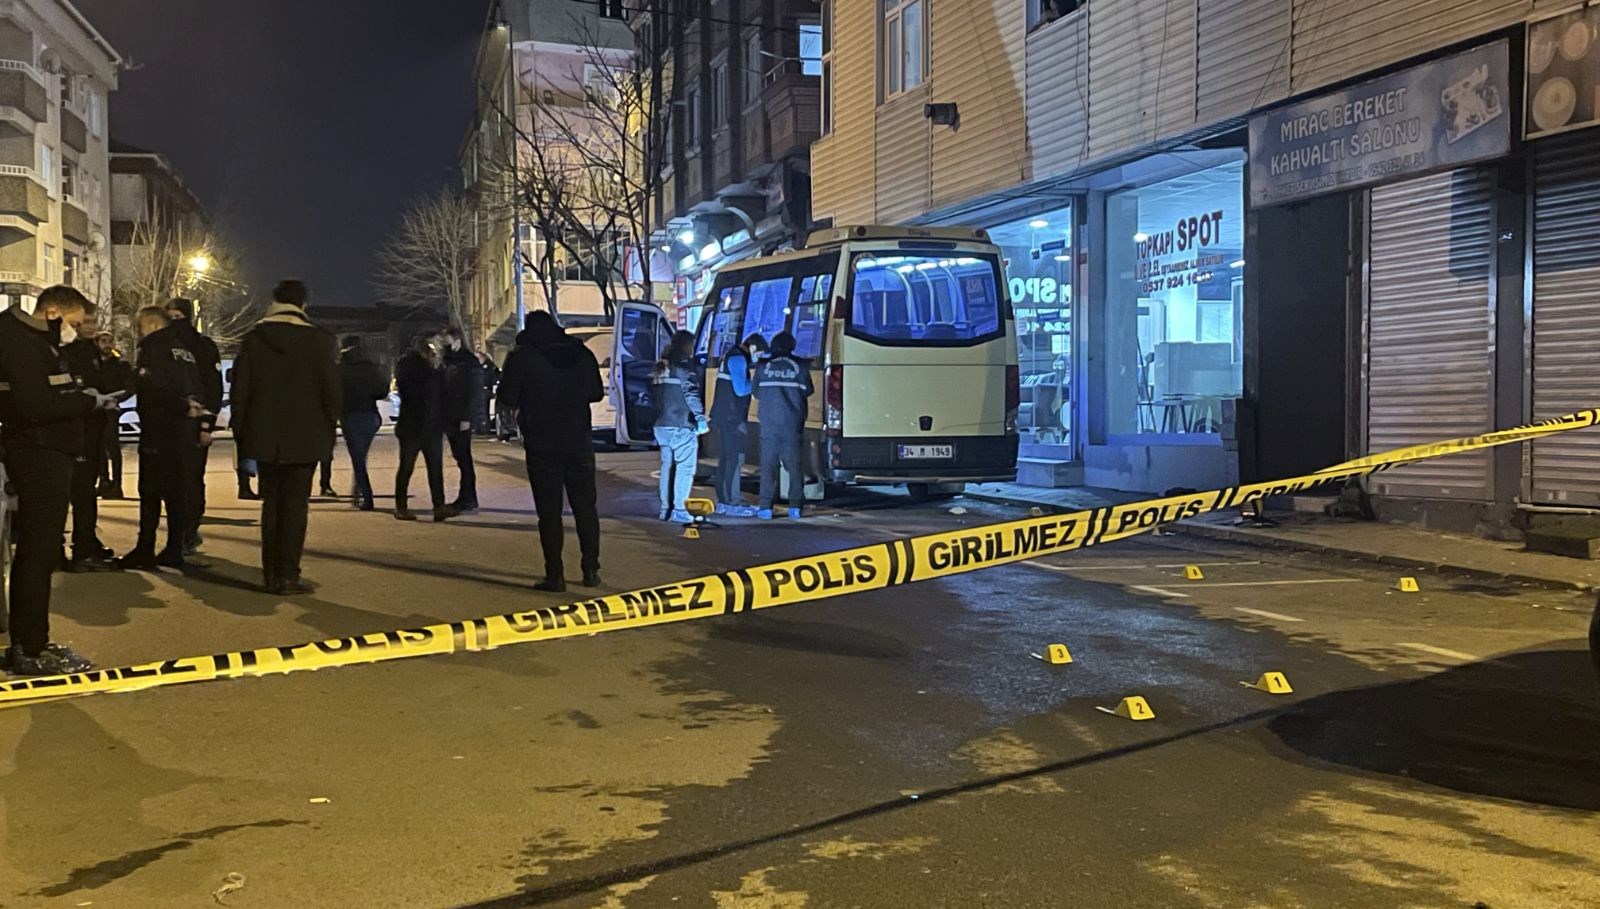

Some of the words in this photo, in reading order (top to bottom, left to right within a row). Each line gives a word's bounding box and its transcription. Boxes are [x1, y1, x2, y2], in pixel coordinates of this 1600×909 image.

[1334, 87, 1407, 129] BEREKET
[1271, 137, 1345, 176] KAHVALTI
[1350, 117, 1421, 157] SALONU
[1136, 230, 1173, 259] TOPKAPI
[1177, 210, 1223, 251] SPOT
[904, 447, 914, 456] 34
[931, 447, 950, 456] 1949
[1057, 648, 1064, 659] 3
[1273, 676, 1282, 688] 1
[1135, 703, 1144, 714] 2
